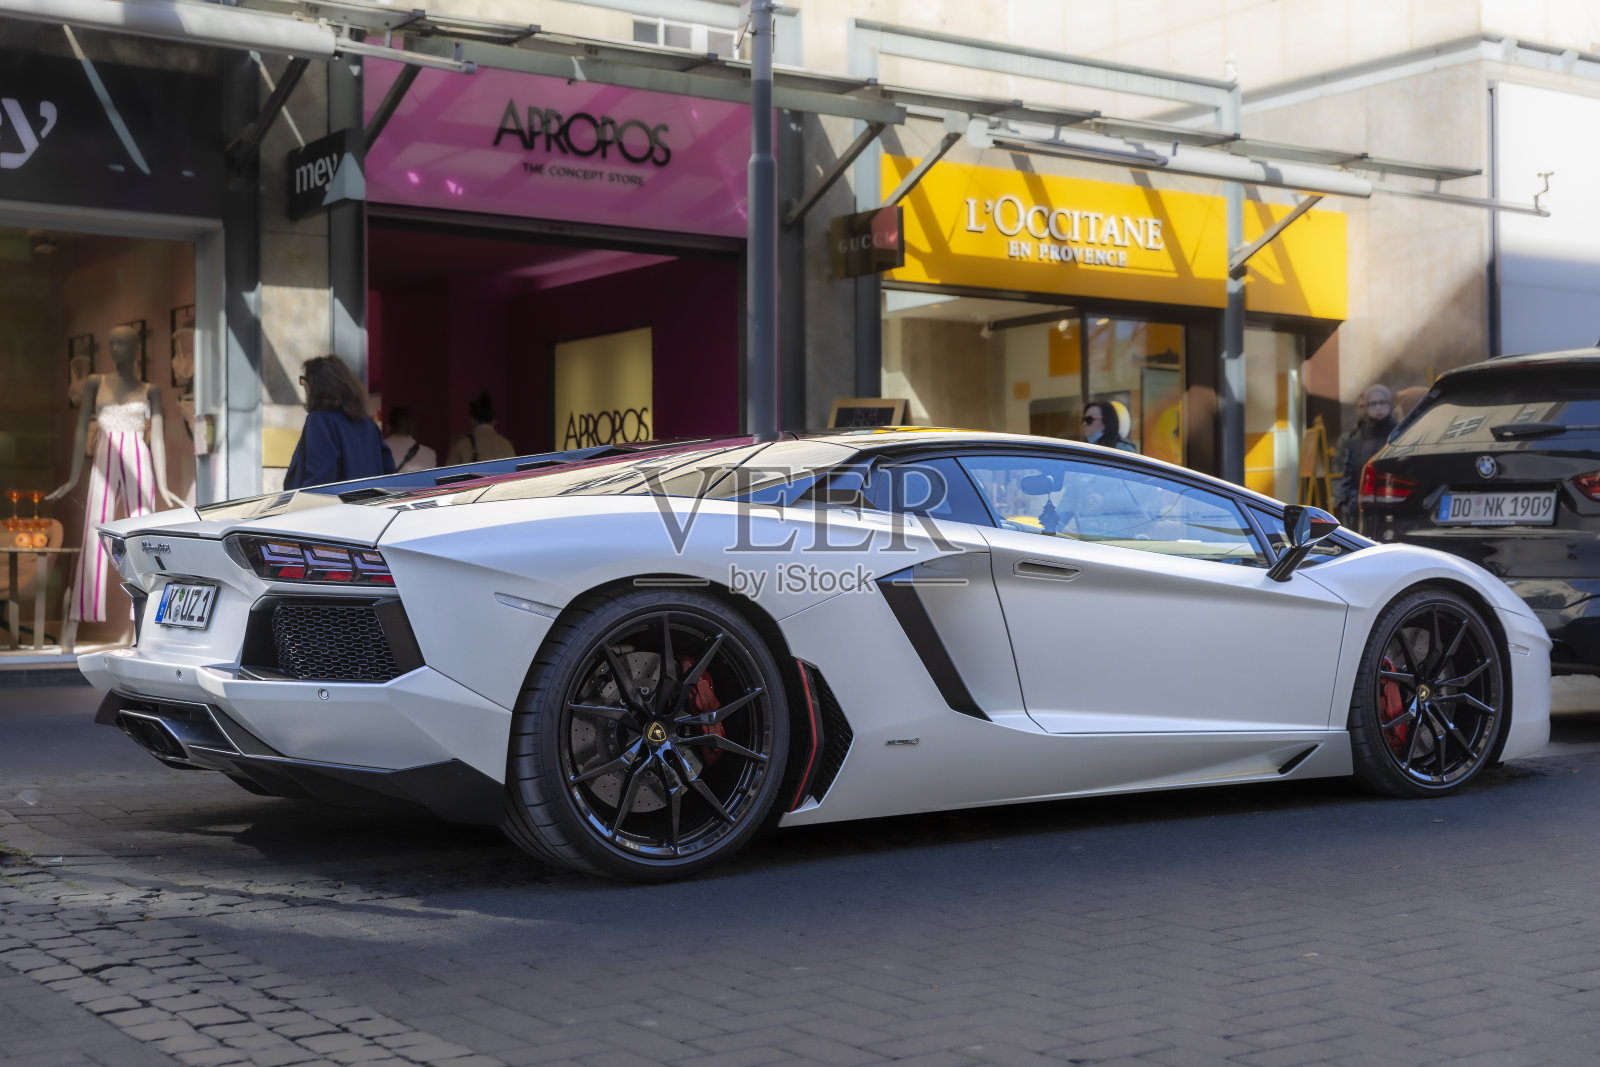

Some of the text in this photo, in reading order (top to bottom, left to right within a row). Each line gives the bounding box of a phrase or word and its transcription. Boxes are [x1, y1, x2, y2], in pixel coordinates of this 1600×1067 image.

[493, 99, 671, 167] APROPOS
[295, 153, 338, 194] mey
[523, 162, 645, 187] THE CONCEPT STORE
[838, 231, 889, 253] GUCCI
[1008, 240, 1128, 267] EN PROVENCE
[564, 407, 650, 450] APROPOS
[1451, 498, 1472, 518] DO
[1508, 496, 1552, 516] 1909
